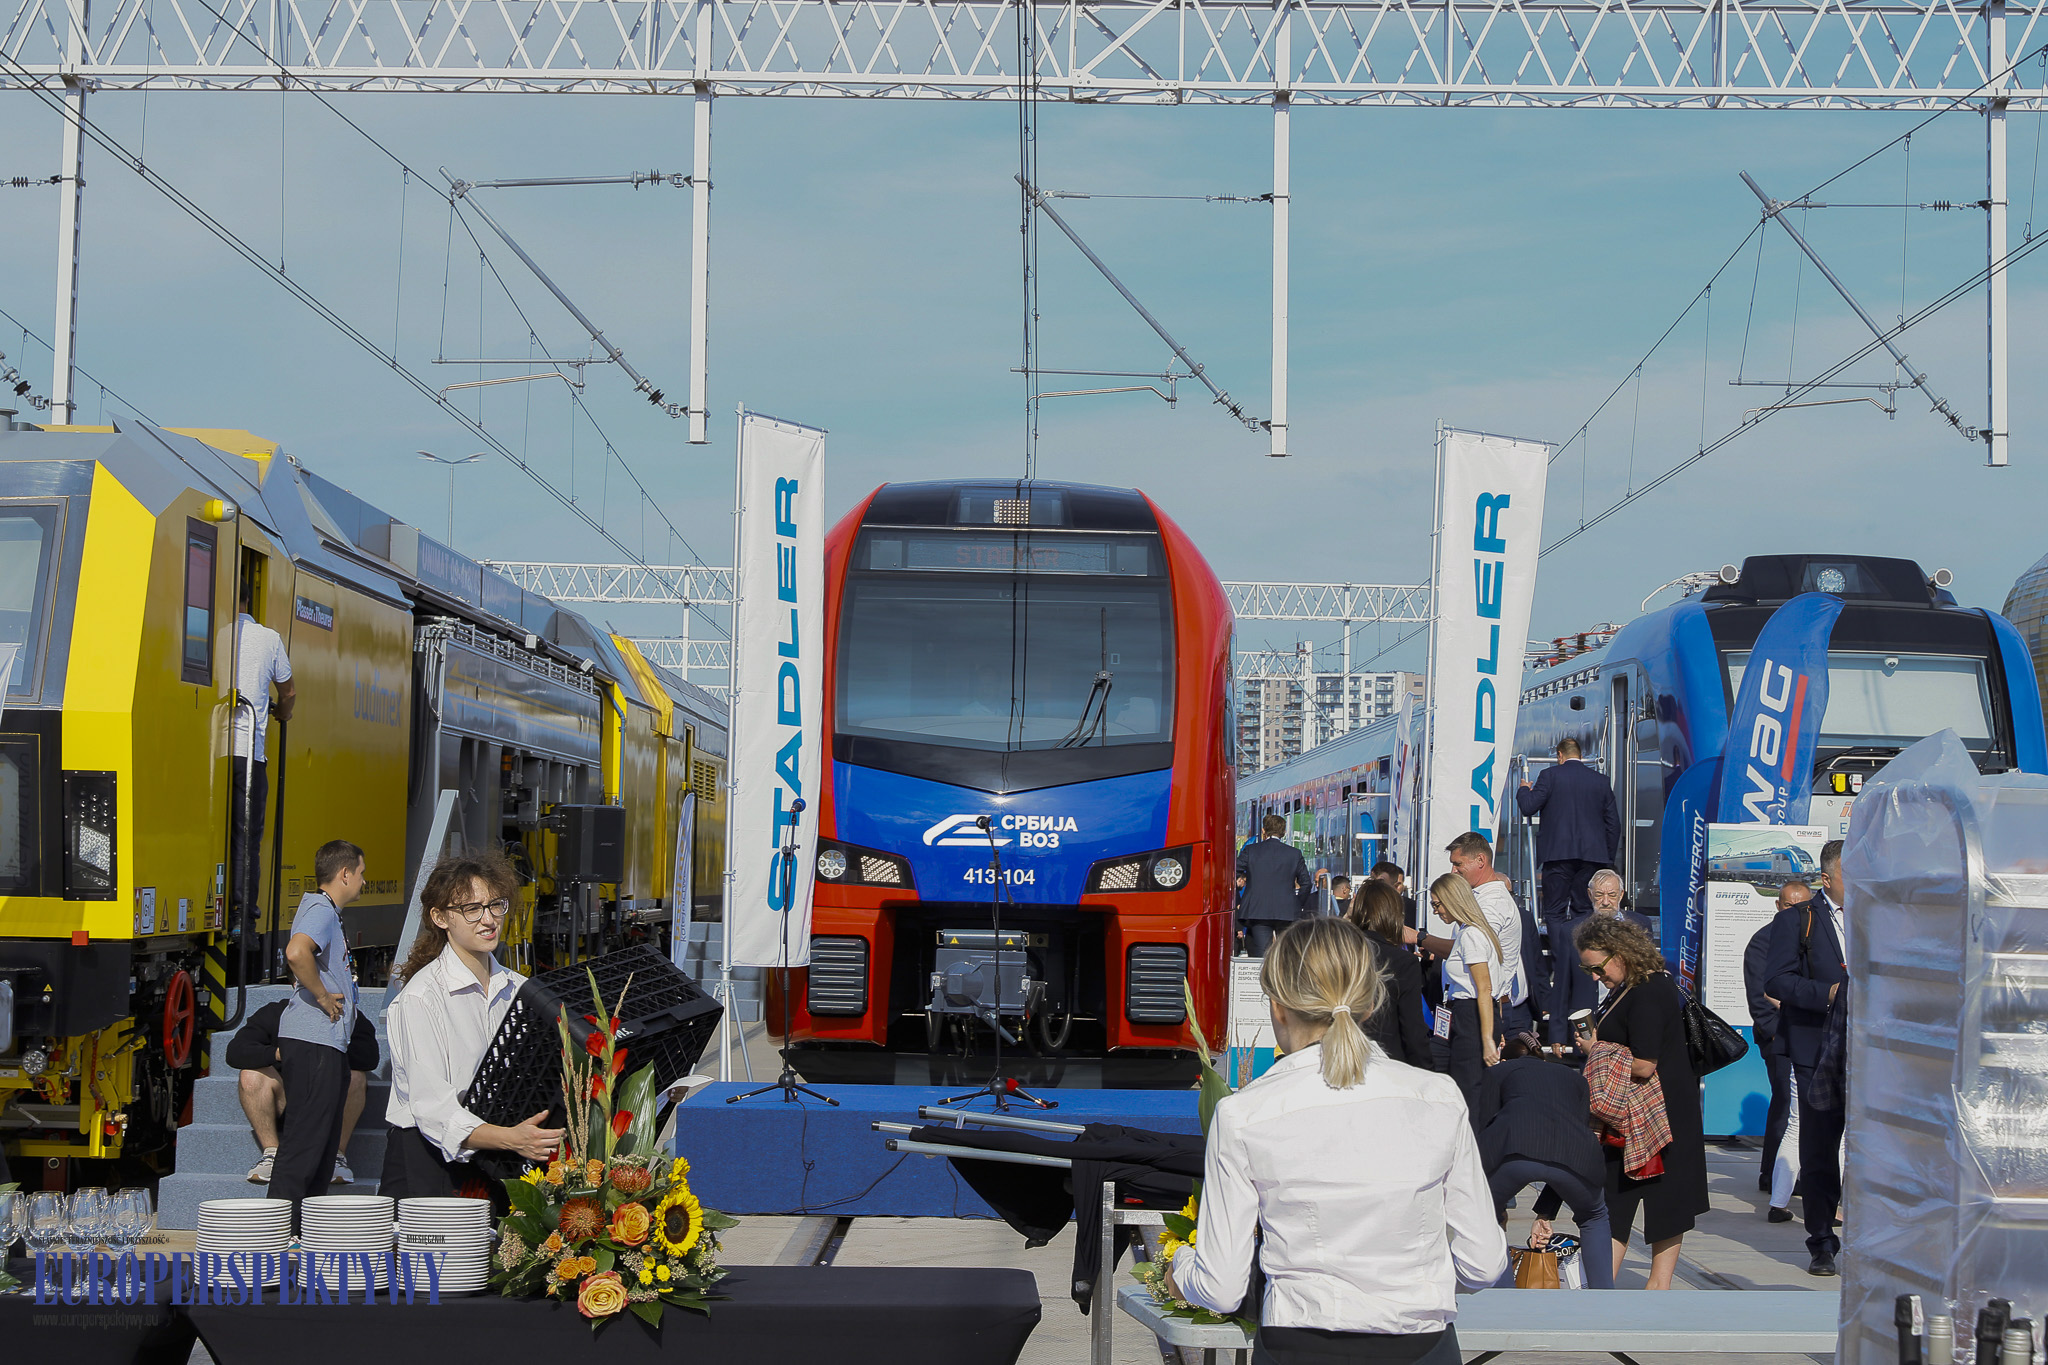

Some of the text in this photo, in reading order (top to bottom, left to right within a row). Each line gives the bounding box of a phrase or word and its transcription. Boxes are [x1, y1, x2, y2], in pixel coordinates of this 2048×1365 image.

[296, 599, 314, 622] Plasser
[315, 606, 332, 628] Theurer
[1470, 491, 1512, 843] TADLER
[354, 661, 402, 728] budimex
[767, 476, 804, 912] STADLER
[1001, 814, 1078, 832] СРБИЈА
[1778, 786, 1789, 825] ROUP
[1020, 832, 1060, 848] ВОЗ
[1689, 809, 1704, 894] INTERCITY
[963, 867, 1036, 885] 413-104
[1685, 895, 1698, 933] PKP
[1734, 898, 1749, 906] 200
